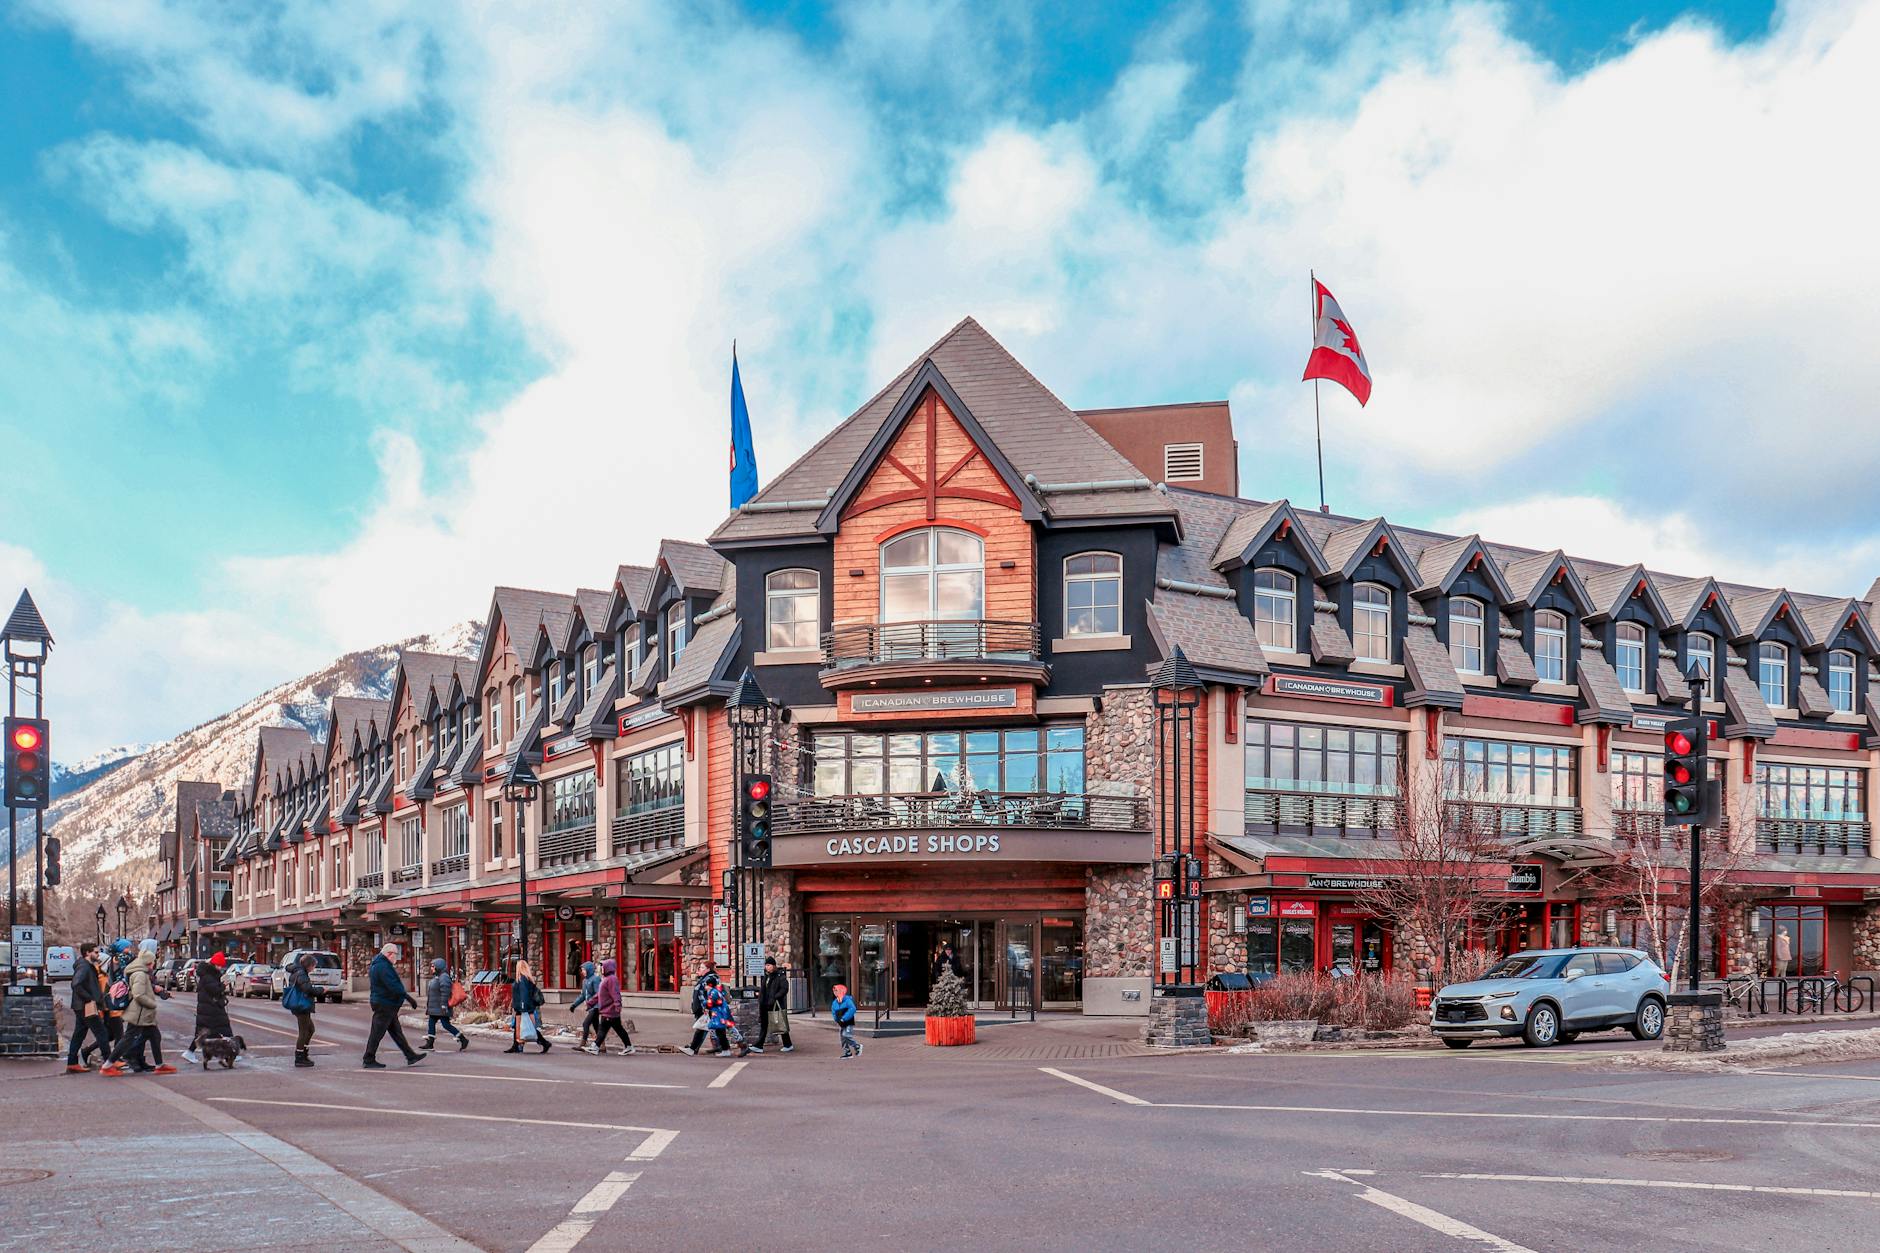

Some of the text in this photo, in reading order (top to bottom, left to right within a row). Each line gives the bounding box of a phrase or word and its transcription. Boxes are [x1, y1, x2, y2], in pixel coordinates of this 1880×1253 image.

[1287, 682, 1326, 692] CANADIAN
[1331, 688, 1376, 698] BREWHOUSE
[865, 698, 920, 707] CANADIAN
[933, 694, 1006, 705] BREWHOUSE
[826, 834, 1000, 856] CASCADE SHOPS
[1331, 879, 1384, 888] BREWHOUSE
[1508, 872, 1537, 883] olumbia
